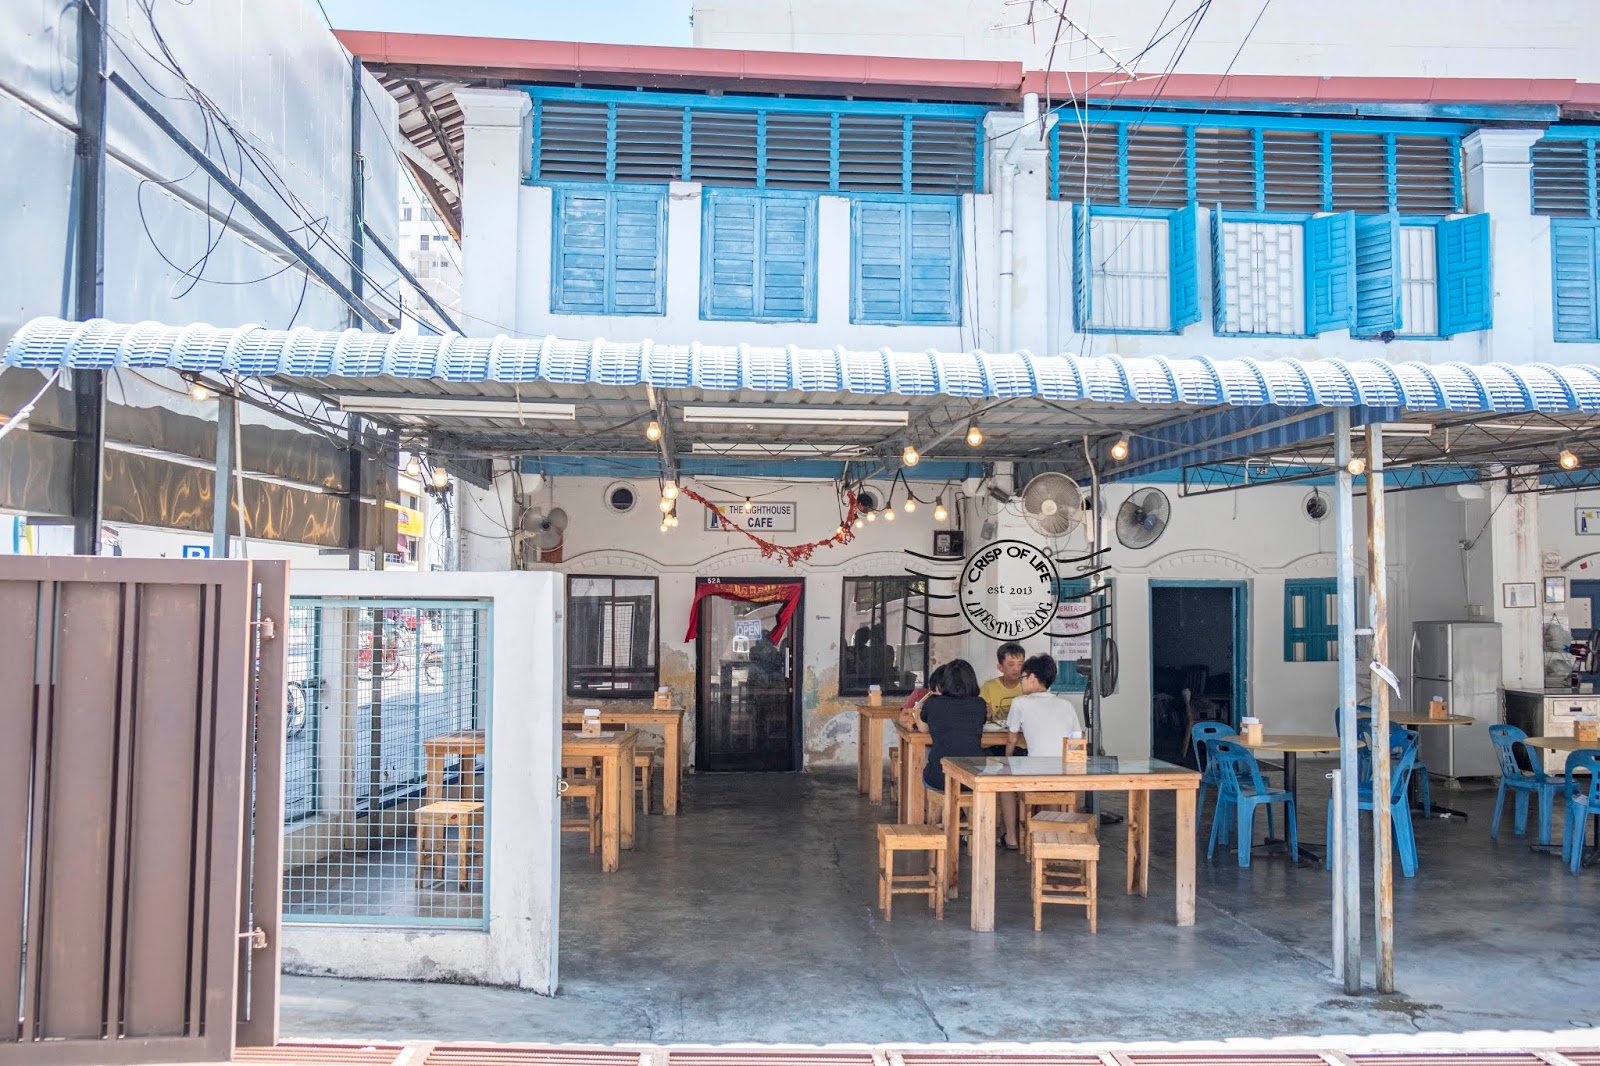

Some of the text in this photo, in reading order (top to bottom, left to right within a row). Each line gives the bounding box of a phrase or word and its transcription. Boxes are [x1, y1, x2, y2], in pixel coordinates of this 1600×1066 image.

[729, 505, 743, 514] THE
[747, 517, 773, 528] CAFE
[737, 623, 760, 636] OPEN
